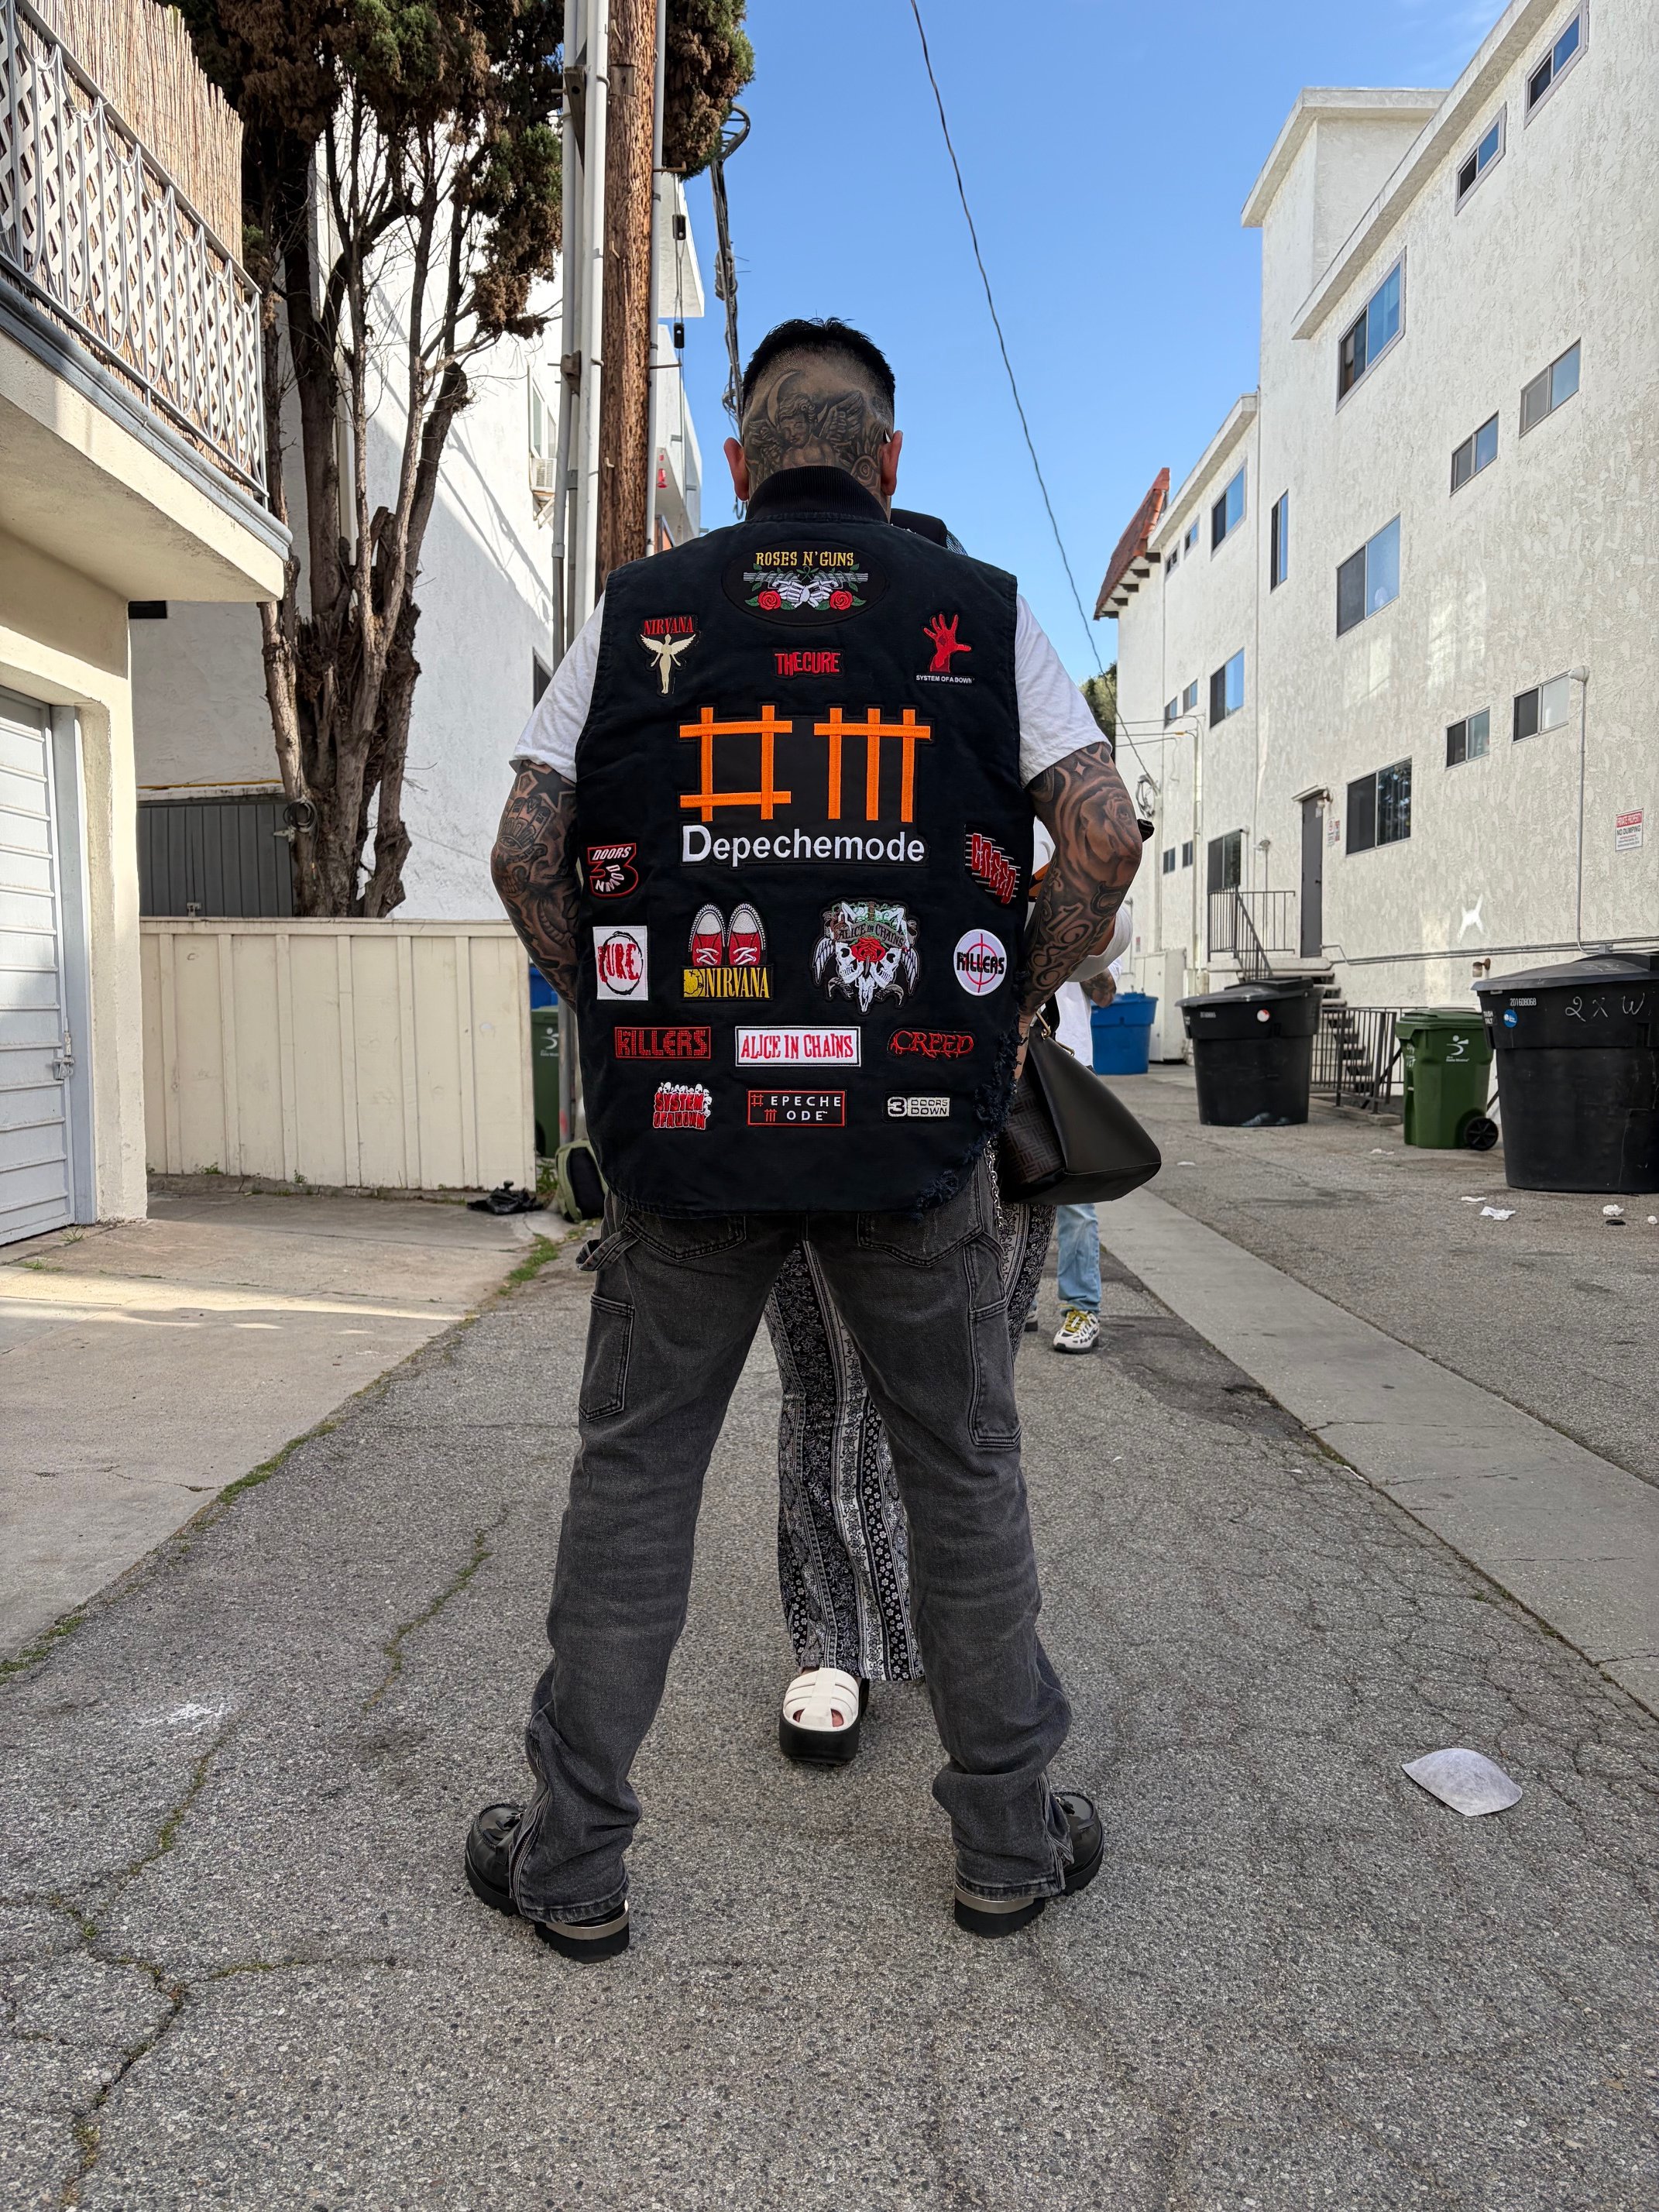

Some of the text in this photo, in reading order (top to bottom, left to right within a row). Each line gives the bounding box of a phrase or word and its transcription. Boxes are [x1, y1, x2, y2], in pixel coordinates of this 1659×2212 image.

[756, 551, 798, 566] ROSES
[819, 551, 854, 566] GUNS
[643, 616, 694, 635] NIRVANA
[1623, 825, 1641, 835] DUMPING
[592, 847, 631, 860] DOORS
[682, 825, 925, 867] Depechemode
[838, 923, 866, 940] ALICE
[875, 923, 904, 946] CHAINS
[706, 967, 770, 998] NIRVANA
[619, 1030, 707, 1056] KILLERS
[740, 1033, 854, 1059] ALICE IN CHAINS
[890, 1030, 974, 1058] CREED
[654, 1092, 704, 1111] SYSTEM
[889, 1098, 905, 1115] 3
